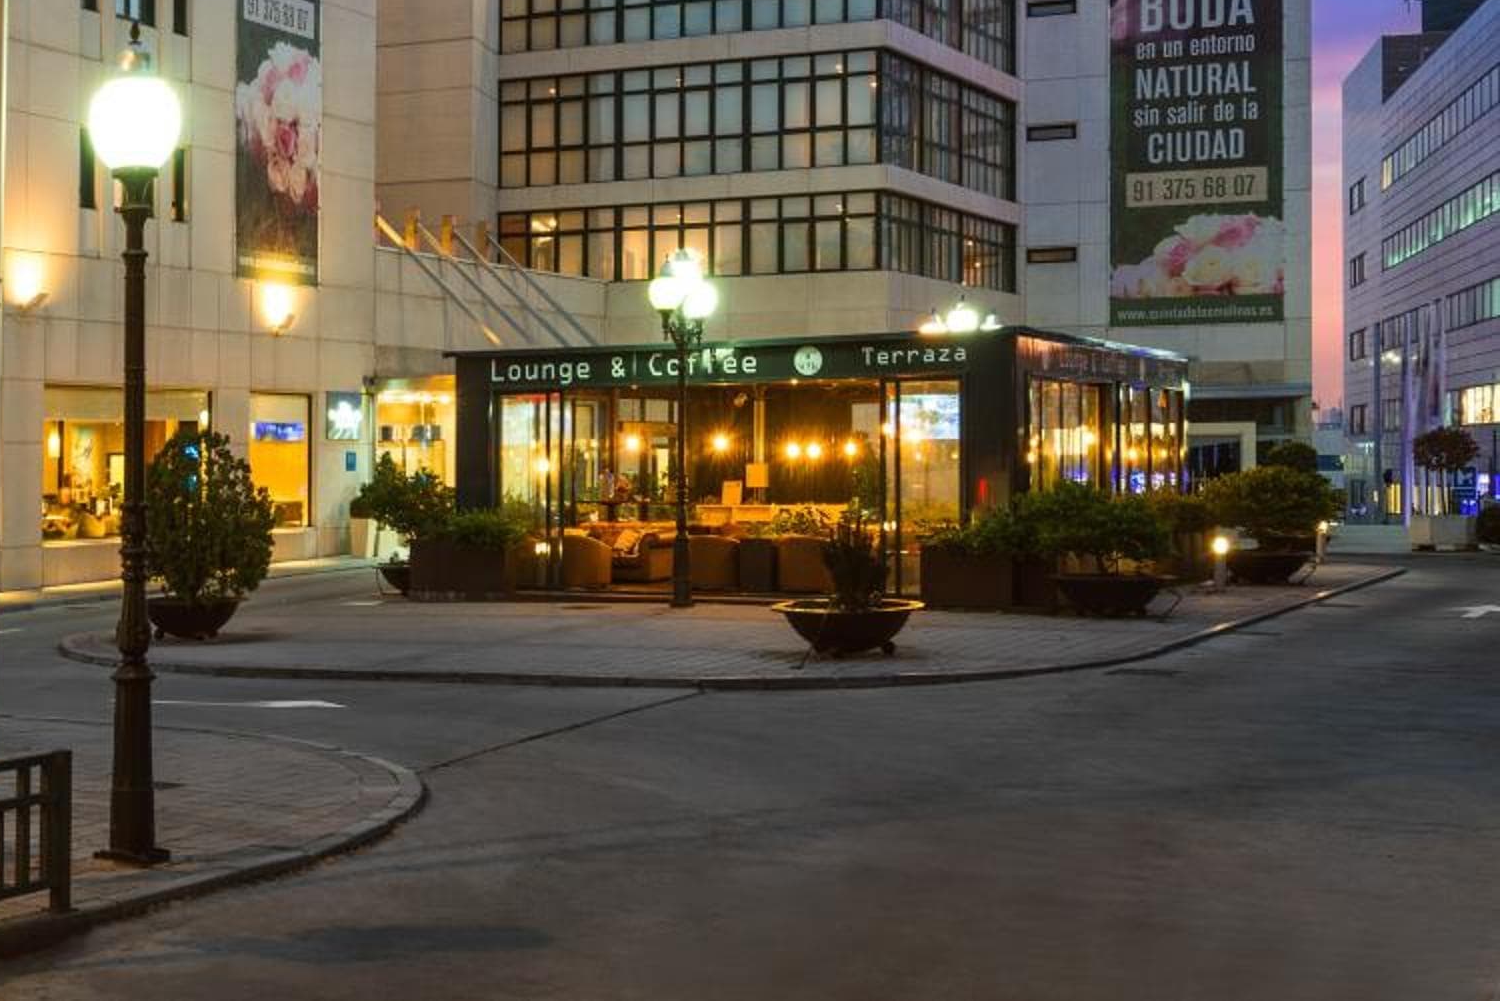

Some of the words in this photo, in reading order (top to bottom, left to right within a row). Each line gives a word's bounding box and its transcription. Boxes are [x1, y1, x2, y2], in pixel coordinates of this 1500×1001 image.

[1136, 41, 1156, 61] en
[1163, 39, 1183, 59] un
[1190, 33, 1256, 56] entorno
[1135, 60, 1257, 101] NATURAL
[1133, 103, 1160, 128] sin
[1167, 101, 1207, 126] salir
[1213, 99, 1235, 121] de
[1242, 97, 1259, 120] la
[1147, 127, 1245, 165] CIUDAD
[1133, 179, 1154, 202] 91
[1162, 176, 1196, 200] 375
[1203, 174, 1228, 199] 68
[1233, 173, 1257, 197] 07
[491, 357, 592, 385] Lounge
[611, 356, 626, 378] &
[648, 349, 758, 377] Coffee
[861, 344, 968, 369] Terraza
